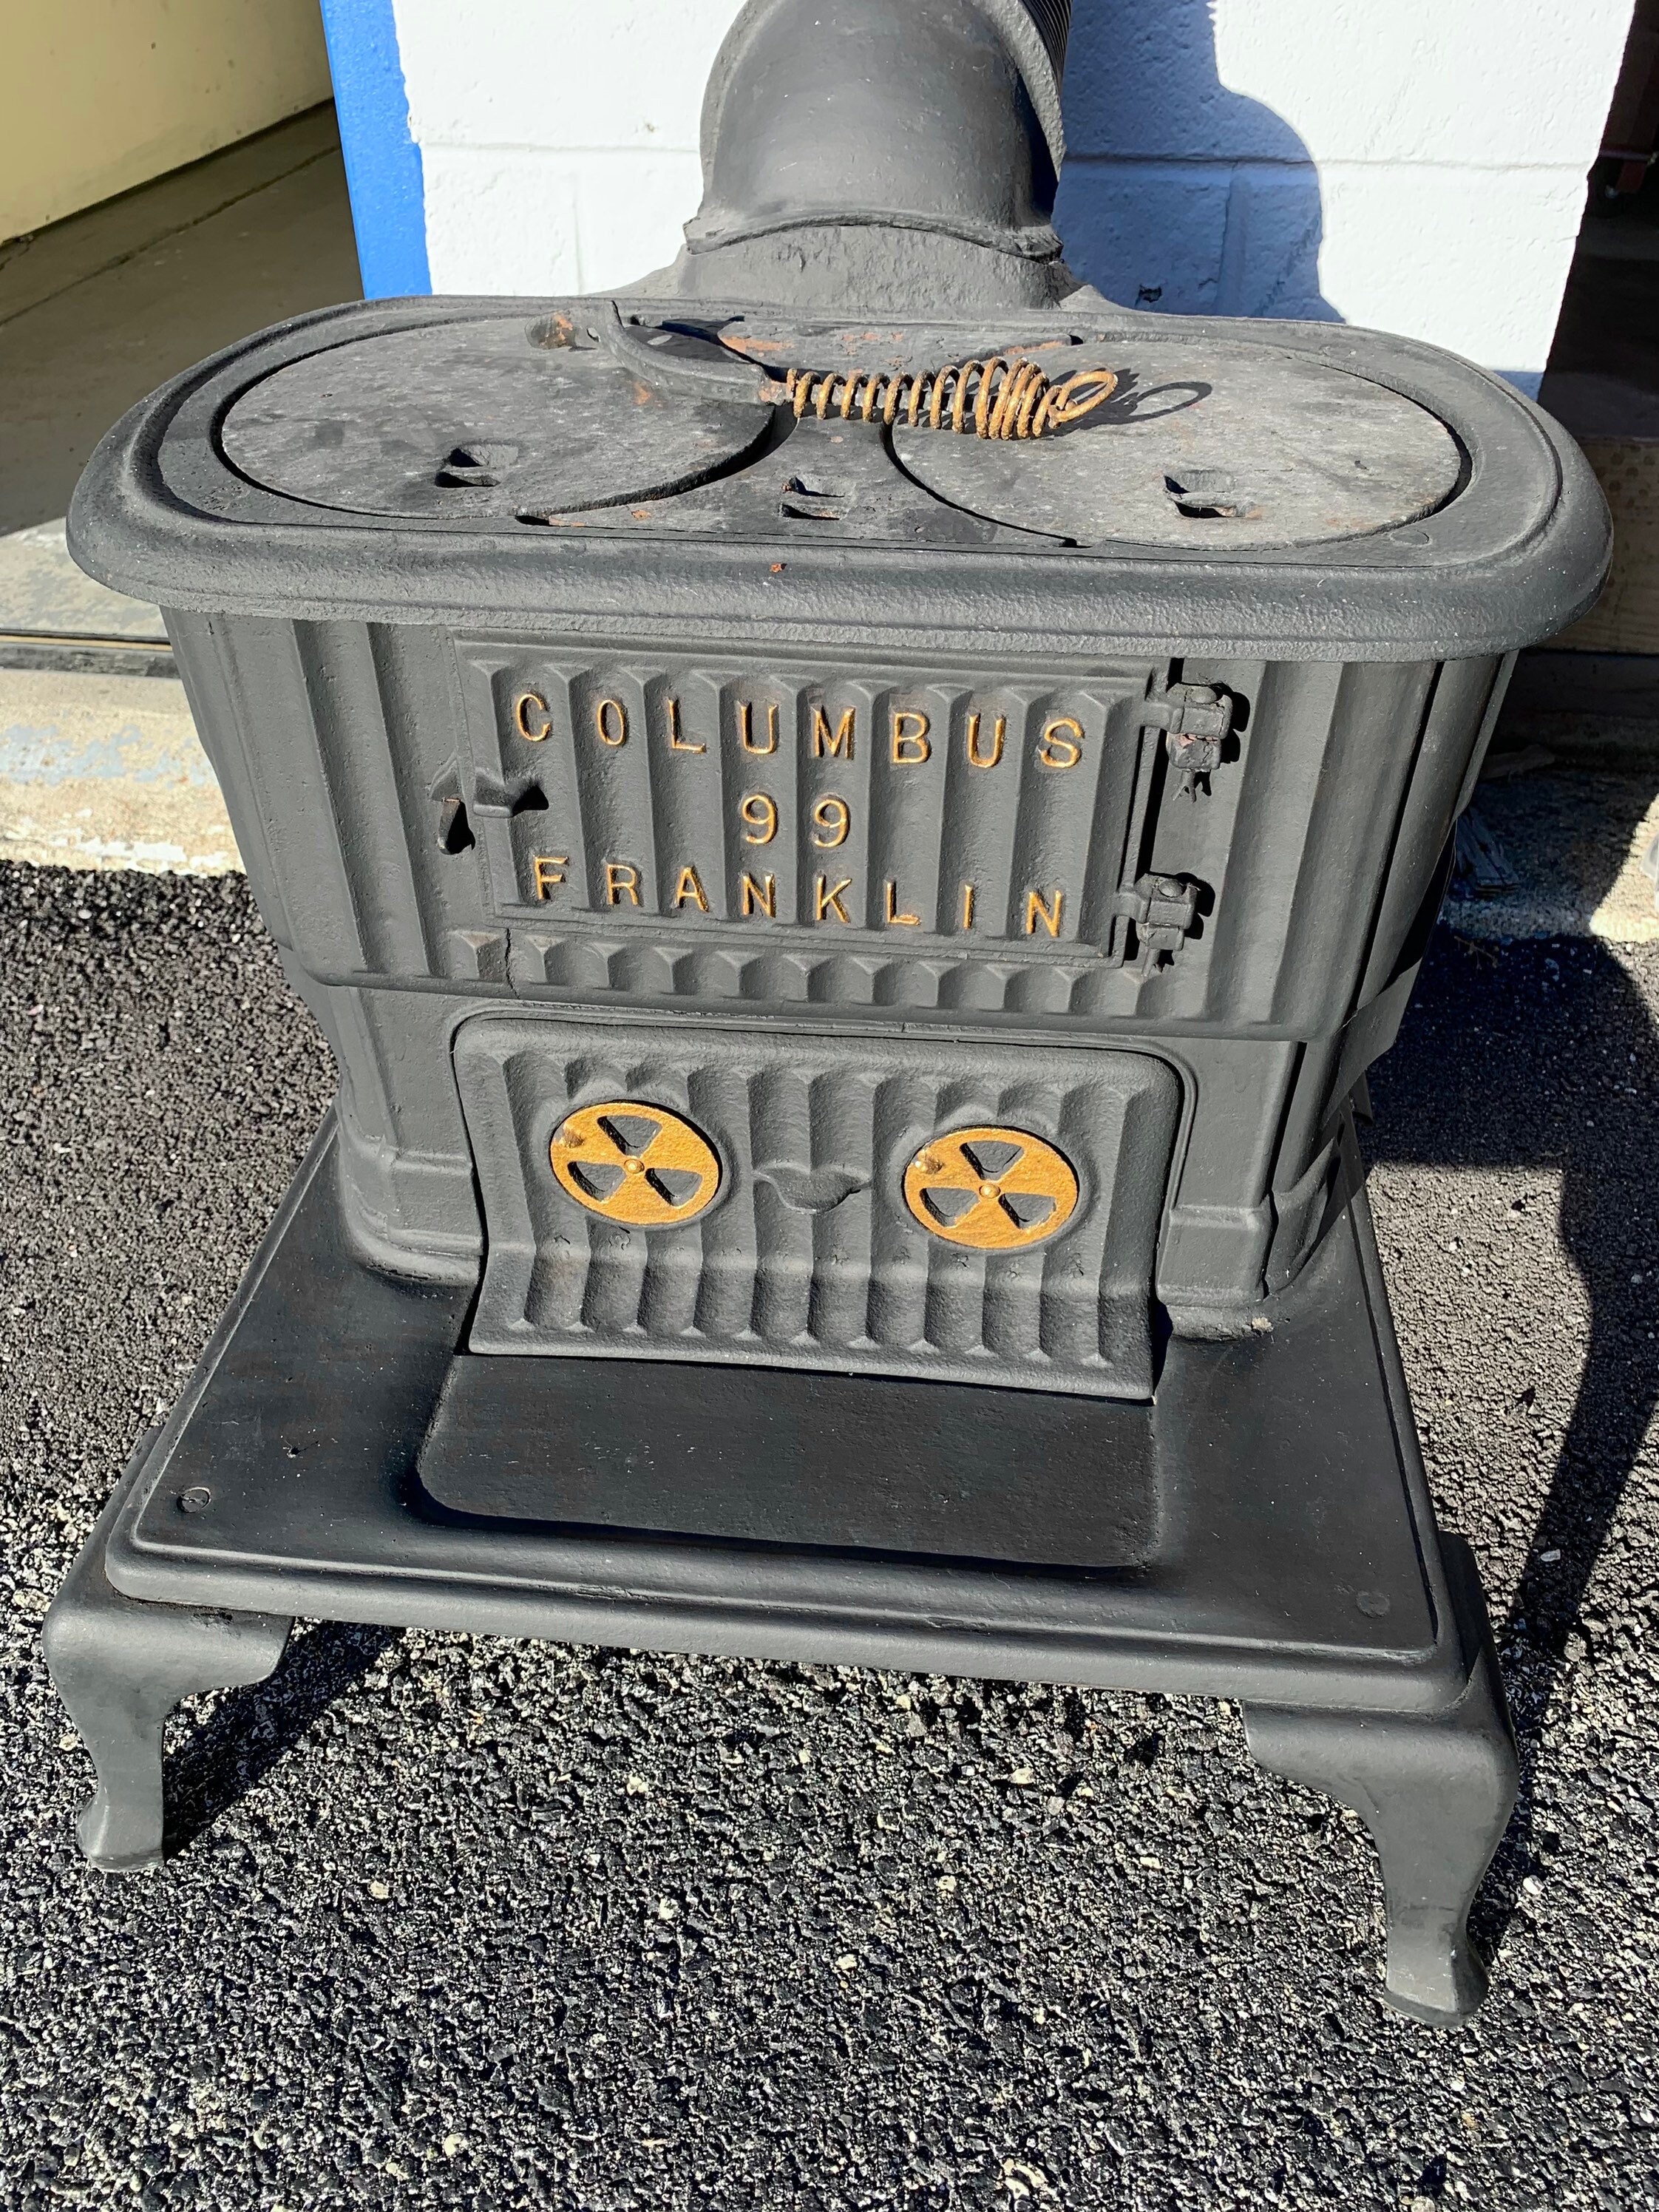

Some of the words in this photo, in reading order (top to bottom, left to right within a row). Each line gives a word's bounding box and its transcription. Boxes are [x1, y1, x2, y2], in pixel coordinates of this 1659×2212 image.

[515, 691, 1085, 770] COLUMBUS
[742, 794, 850, 848] 99
[534, 855, 1063, 937] FRANKLIN
